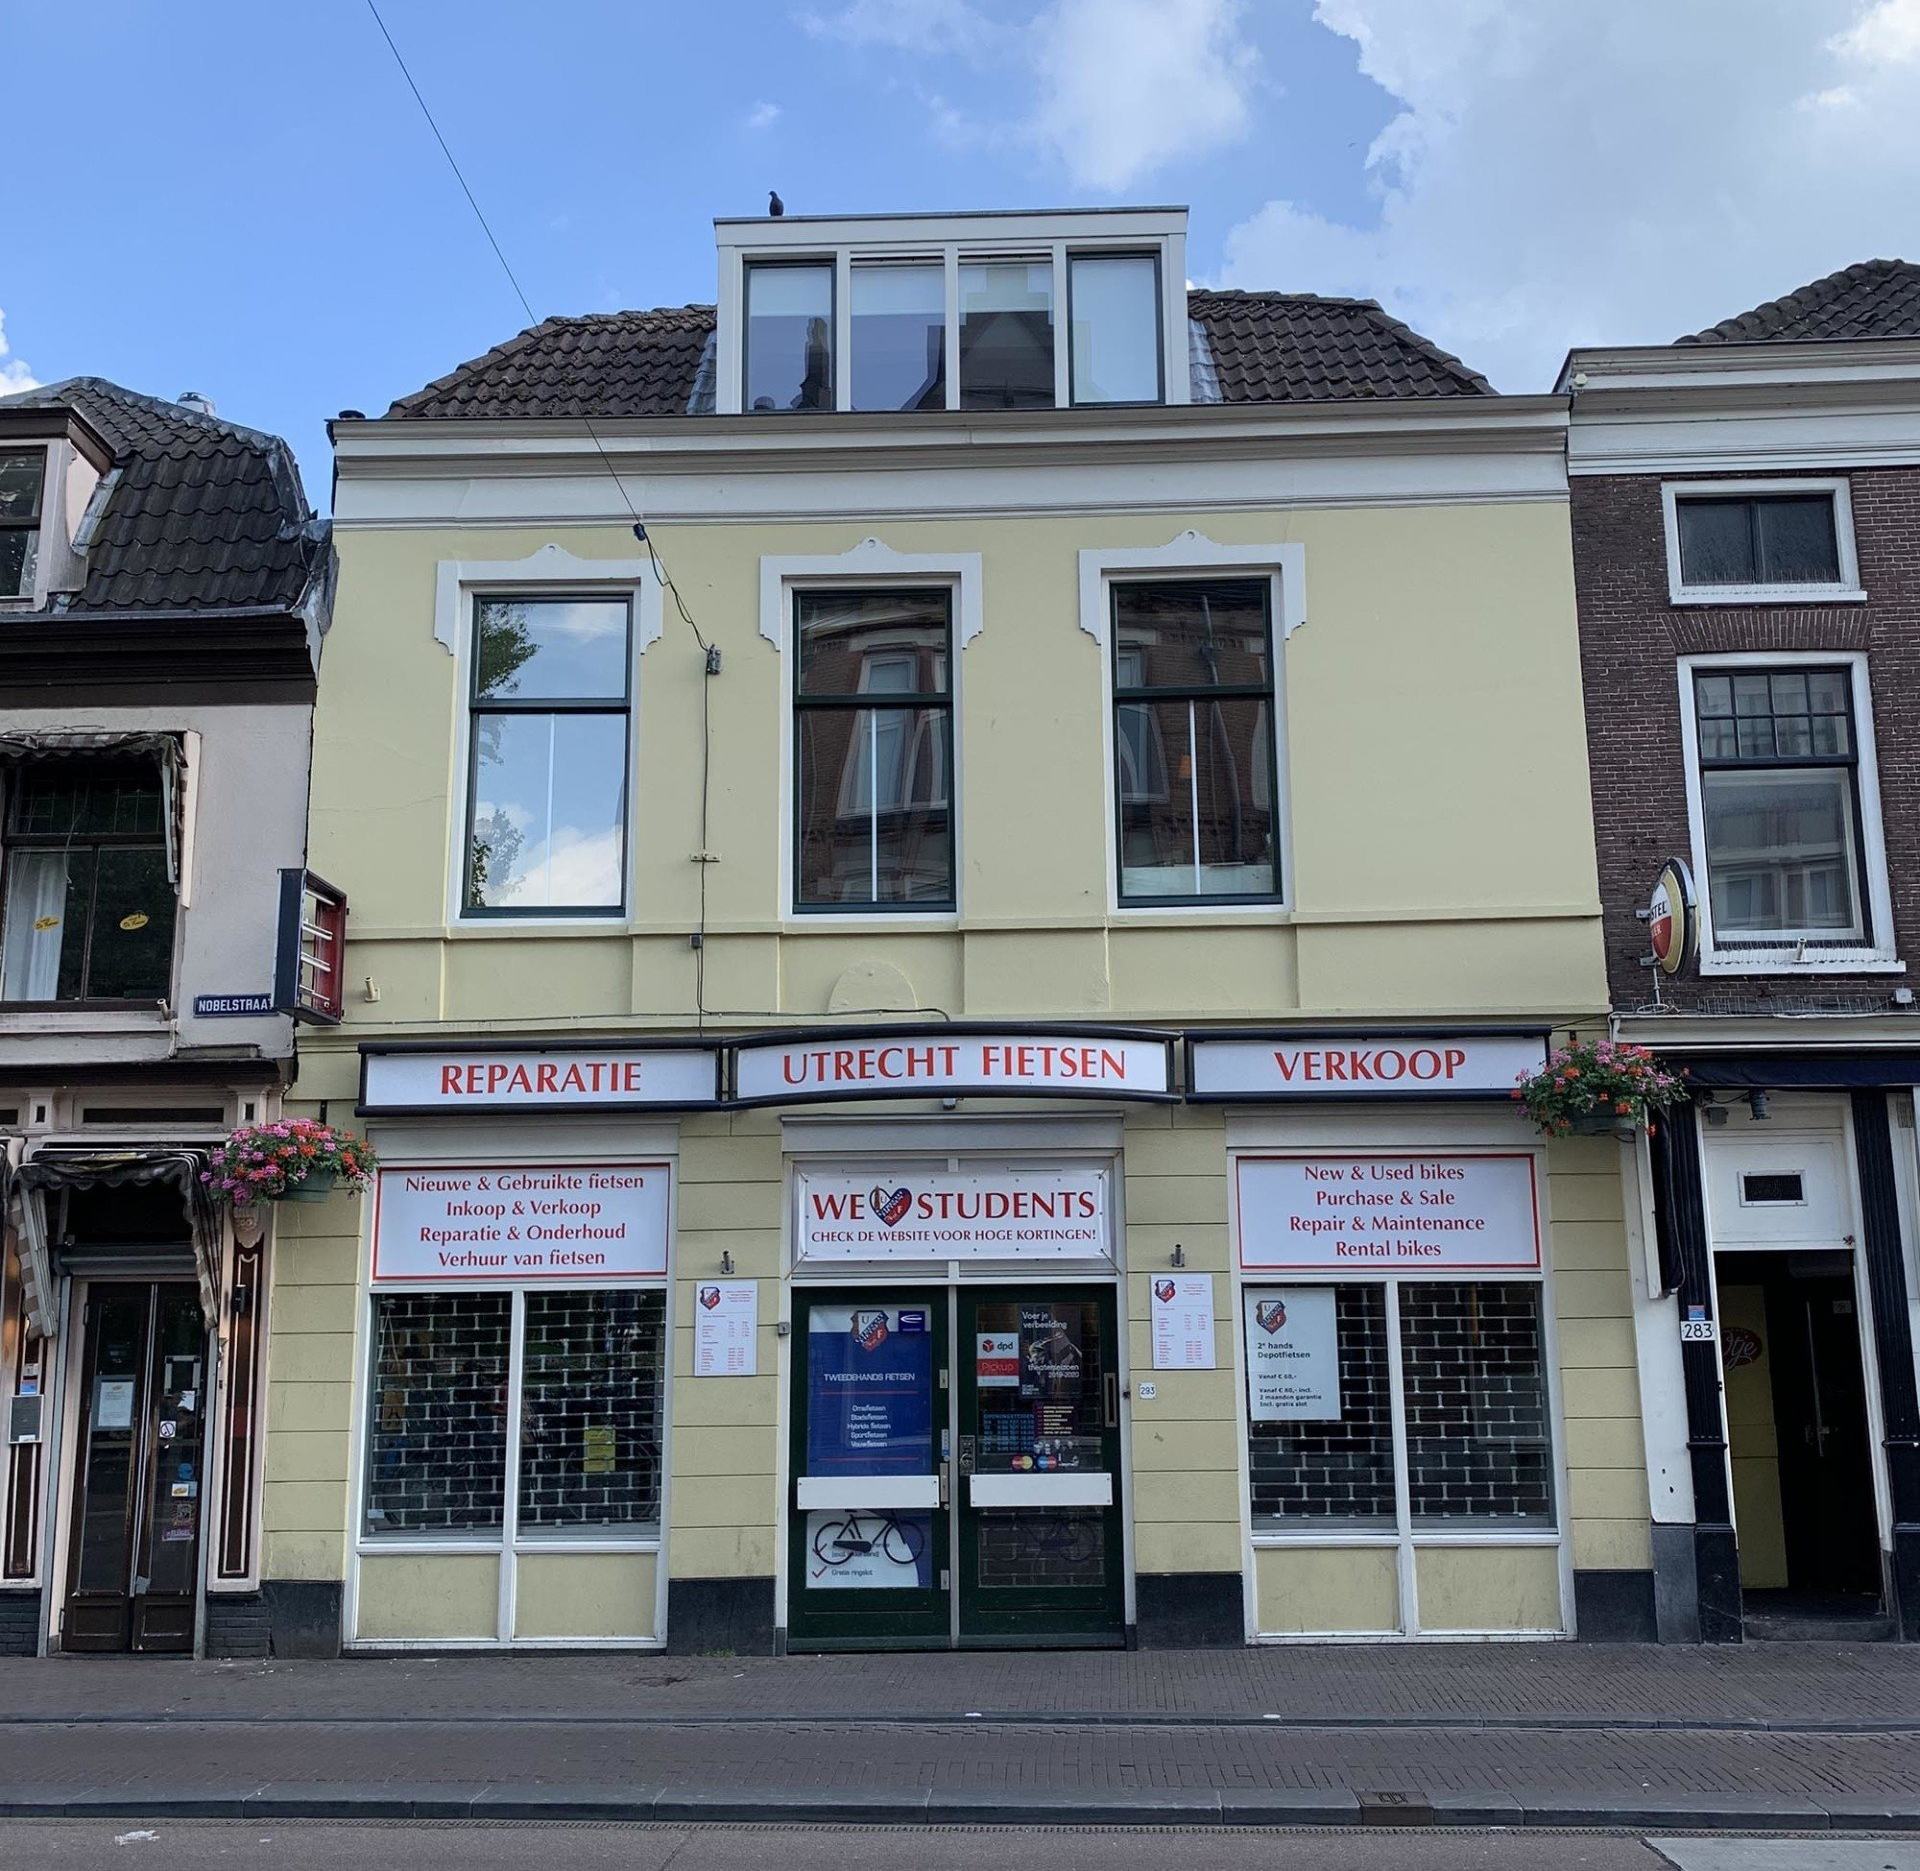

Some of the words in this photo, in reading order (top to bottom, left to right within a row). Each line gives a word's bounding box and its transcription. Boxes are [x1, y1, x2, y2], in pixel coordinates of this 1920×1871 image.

[1650, 901, 1667, 921] STEL
[783, 1045, 960, 1084] UTRECHT
[982, 1045, 1126, 1080] FIETSEN
[1274, 1049, 1466, 1081] VERKOOP
[441, 1062, 642, 1095] REPARATIE
[1304, 1165, 1344, 1180] New
[1351, 1165, 1365, 1180] &
[1371, 1164, 1414, 1180] Used
[1420, 1163, 1464, 1180] bikes
[405, 1176, 471, 1192] Nieuwe
[477, 1176, 491, 1191] &
[498, 1174, 582, 1191] Gebruikte
[588, 1174, 644, 1189] fietsen
[812, 1193, 865, 1220] WE
[917, 1191, 1095, 1219] STUDENTS
[1316, 1189, 1394, 1206] Purchase
[1400, 1190, 1413, 1205] &
[1420, 1189, 1455, 1205] Sale
[447, 1200, 506, 1220] Inkoop
[512, 1201, 525, 1216] &
[530, 1198, 601, 1219] Verkoop
[1290, 1215, 1345, 1235] Repair
[1352, 1216, 1366, 1231] &
[1372, 1214, 1485, 1231] Maintenance
[420, 1224, 501, 1246] Reparatie
[507, 1226, 521, 1240] &
[527, 1222, 626, 1240] Onderhoud
[811, 1231, 854, 1242] CHECK
[858, 1231, 874, 1242] DE
[878, 1230, 930, 1241] WEBSITE
[933, 1230, 971, 1241] VOOR
[975, 1229, 1013, 1241] HOGE
[1017, 1229, 1096, 1240] KORTINGEN!
[1336, 1240, 1390, 1256] Rental
[1397, 1239, 1442, 1256] bikes
[439, 1250, 508, 1267] Verhuur
[514, 1254, 543, 1266] van
[549, 1250, 605, 1265] fietsen
[1684, 1323, 1713, 1338] 283
[997, 1342, 1014, 1352] dpd
[1268, 1342, 1294, 1350] hands
[1257, 1352, 1311, 1360] Depotfietsen
[824, 1373, 884, 1382] TWEEDEHANDS
[885, 1372, 916, 1381] FIETSEN
